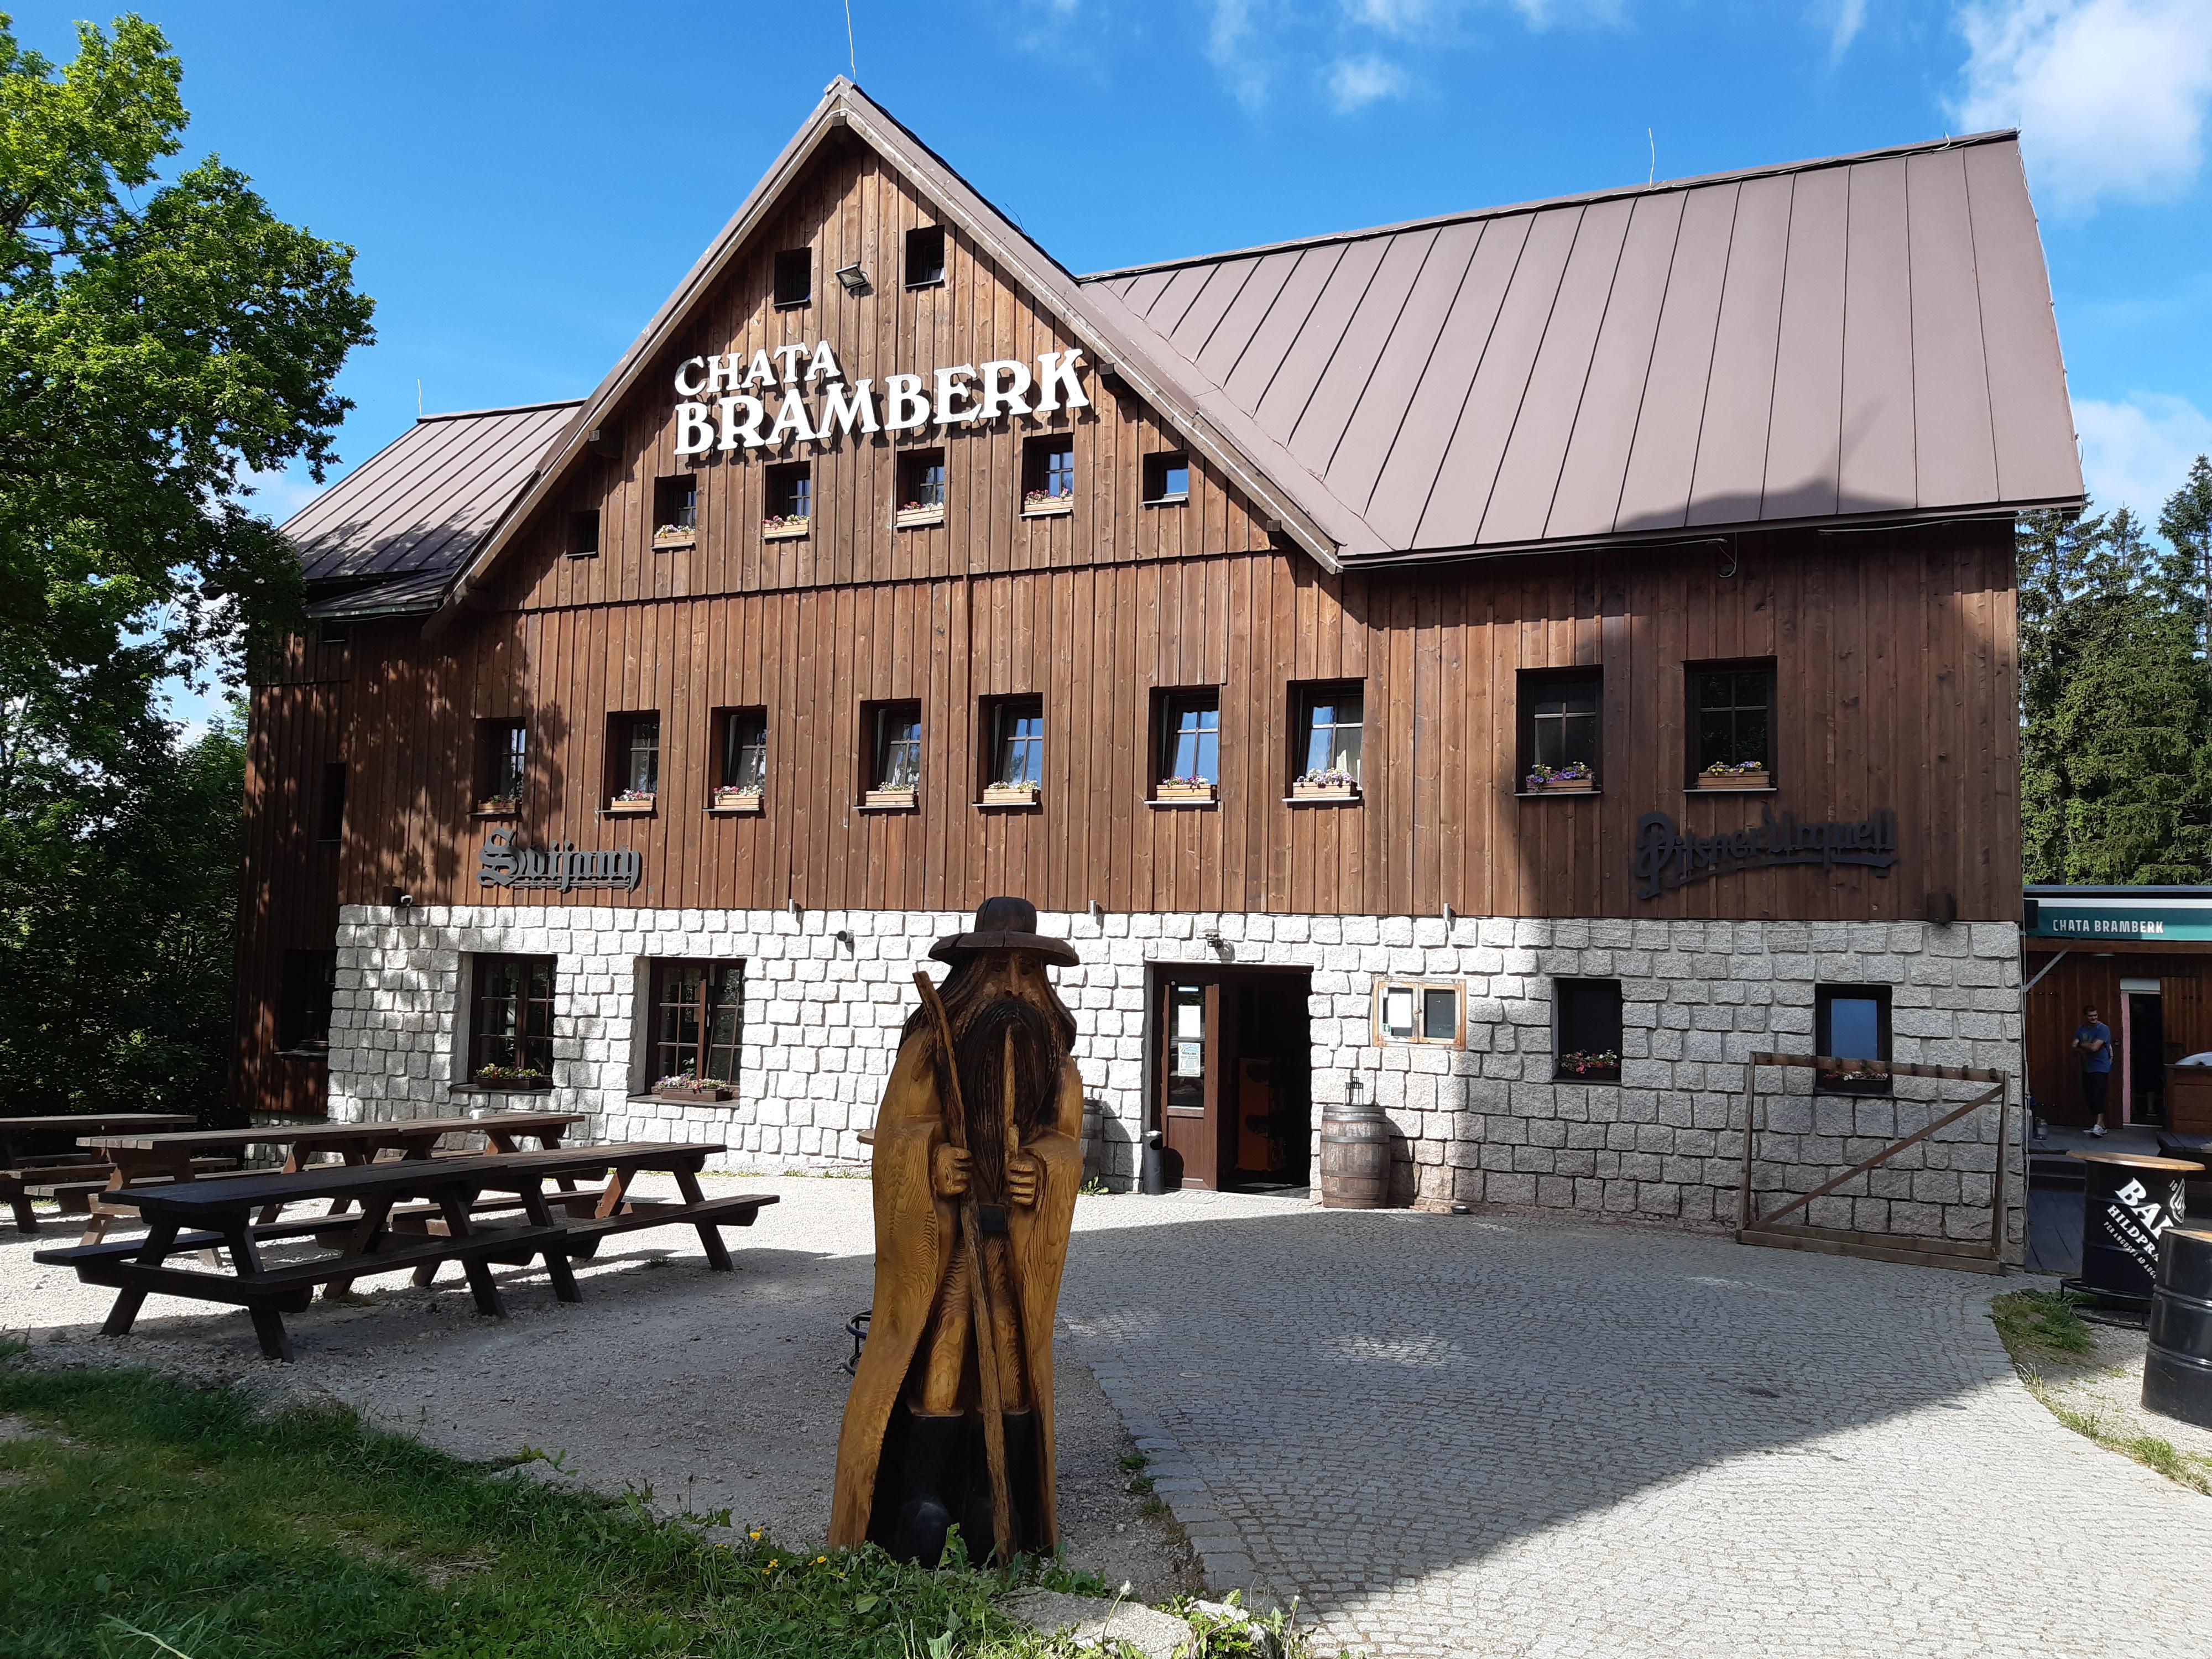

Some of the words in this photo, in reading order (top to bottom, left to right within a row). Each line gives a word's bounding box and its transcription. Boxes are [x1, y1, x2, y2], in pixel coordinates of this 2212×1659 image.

[674, 348, 1089, 455] BRAMBERK
[675, 340, 842, 396] CHATA
[477, 826, 640, 893] Svijany
[1635, 812, 1763, 899] Pilsner
[1762, 802, 1894, 870] Urquell
[2052, 919, 2090, 932] CHATA
[2094, 920, 2164, 933] BRAMBERK
